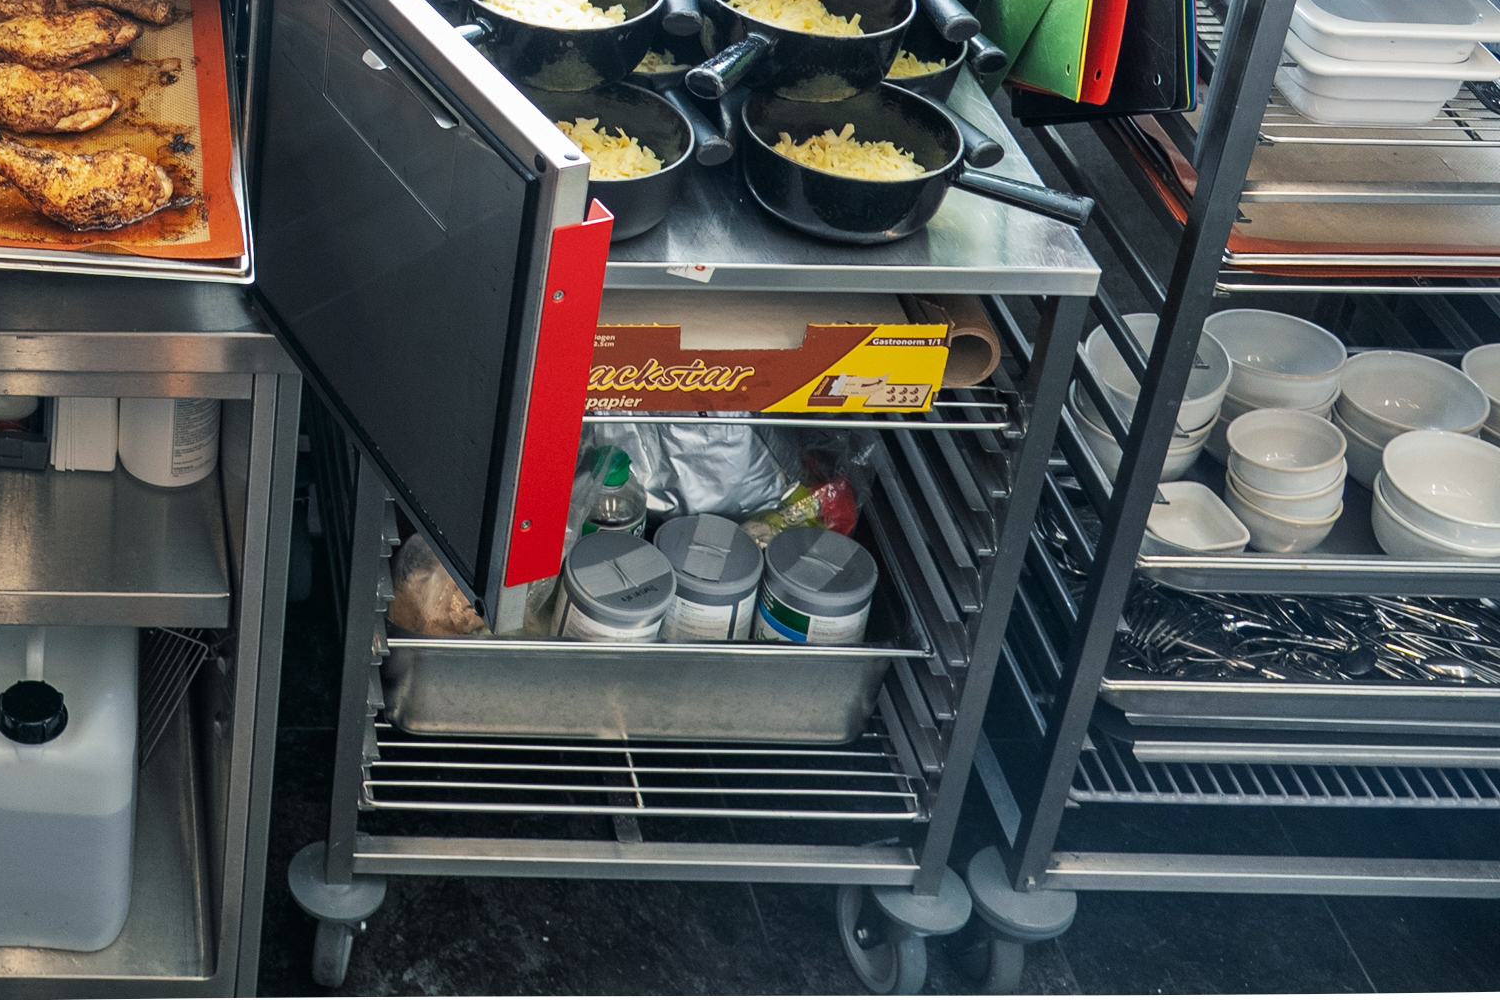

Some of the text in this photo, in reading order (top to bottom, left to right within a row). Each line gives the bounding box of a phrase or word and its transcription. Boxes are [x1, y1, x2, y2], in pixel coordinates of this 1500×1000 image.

[872, 338, 941, 346] Gastronorm 1/1
[588, 357, 755, 392] ackstar
[585, 395, 643, 410] papier
